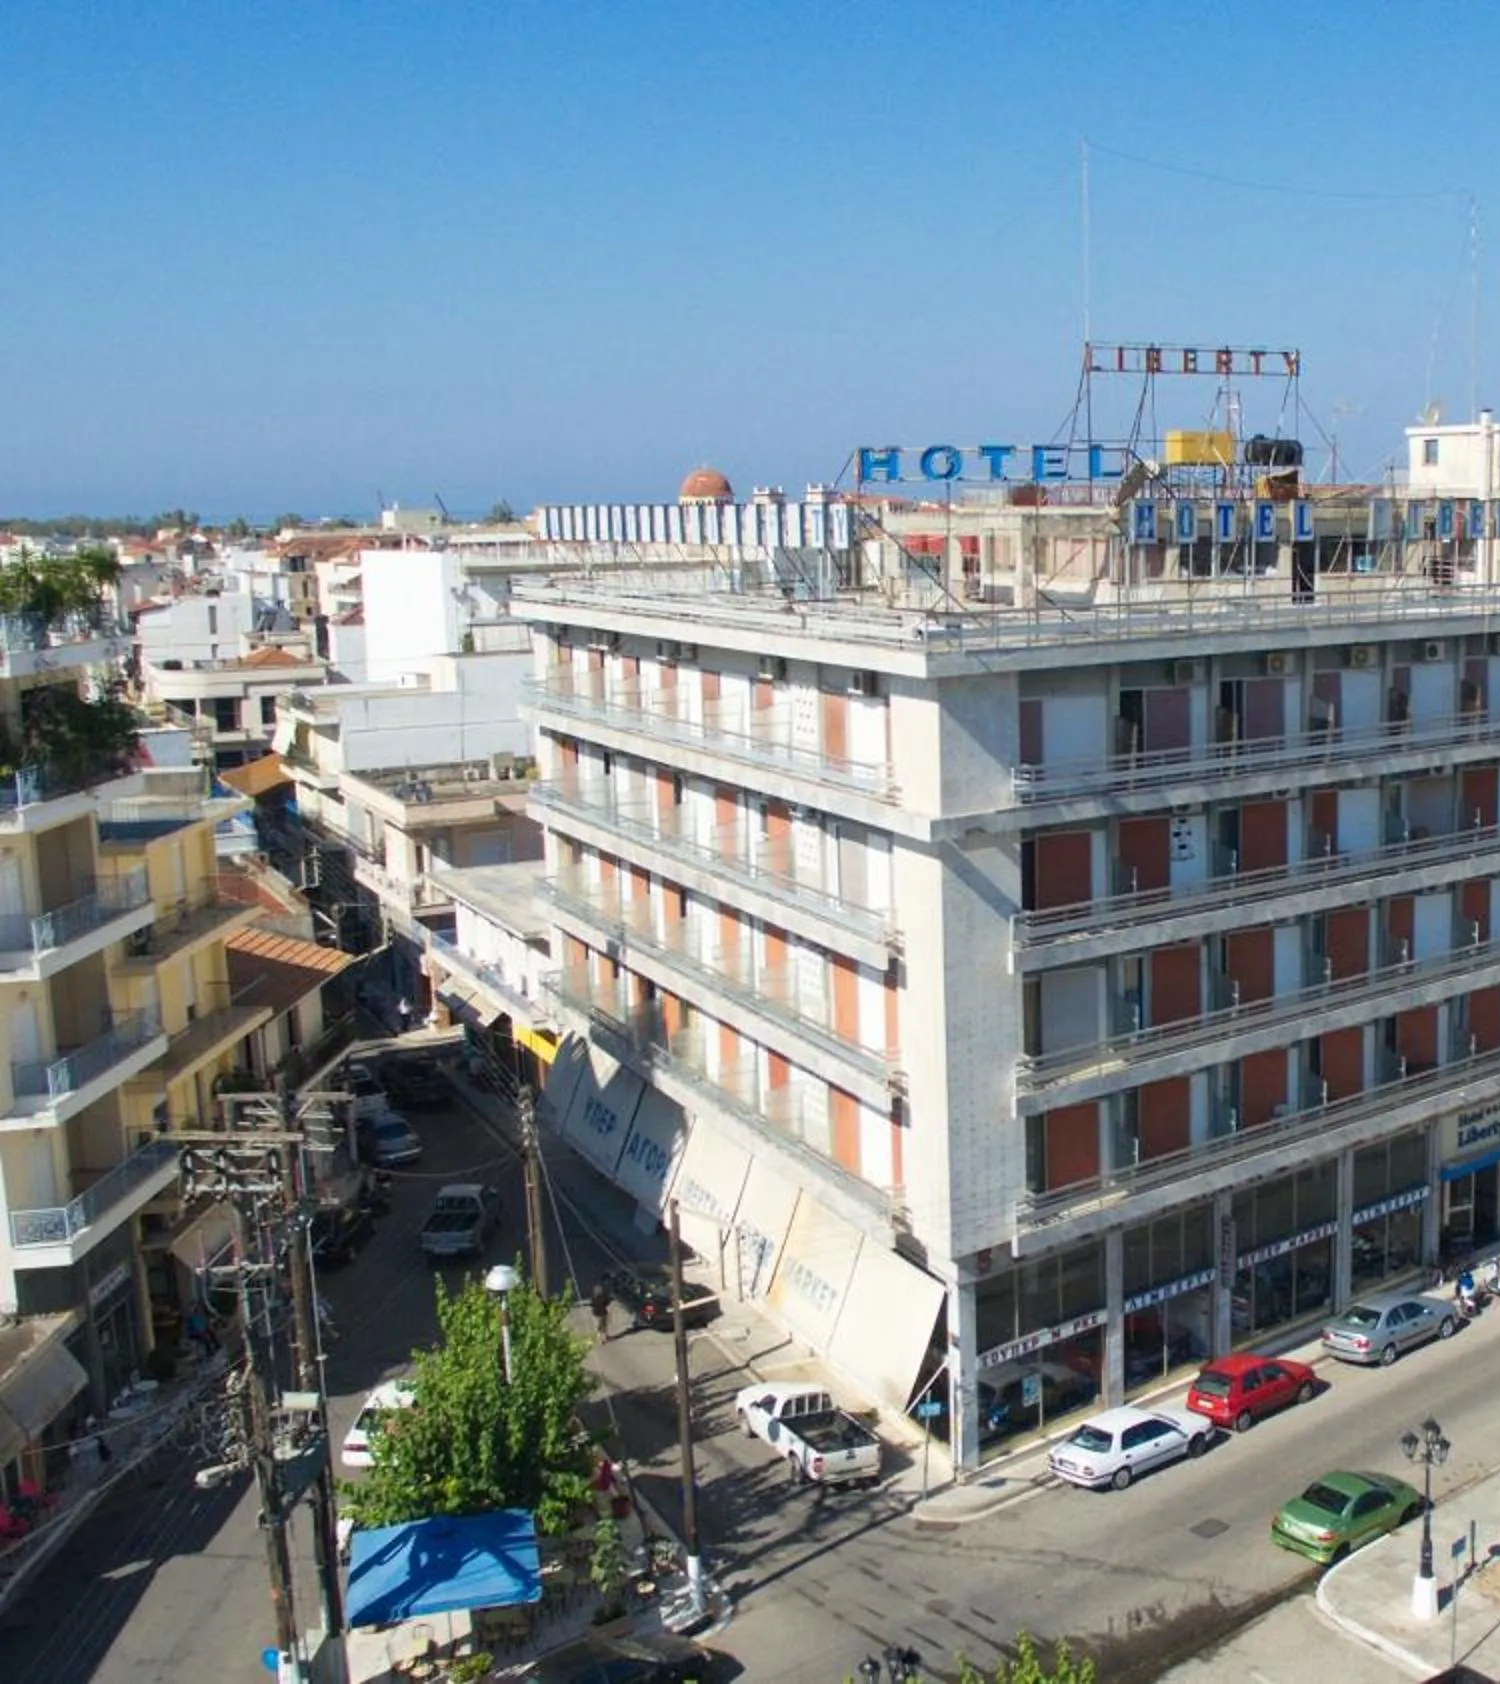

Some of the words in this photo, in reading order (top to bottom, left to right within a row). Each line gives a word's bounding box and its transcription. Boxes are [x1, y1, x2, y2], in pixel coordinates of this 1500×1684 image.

[1086, 347, 1298, 375] LIBERTY
[859, 445, 1123, 480] HOTEL
[1135, 503, 1314, 539] HOTEL
